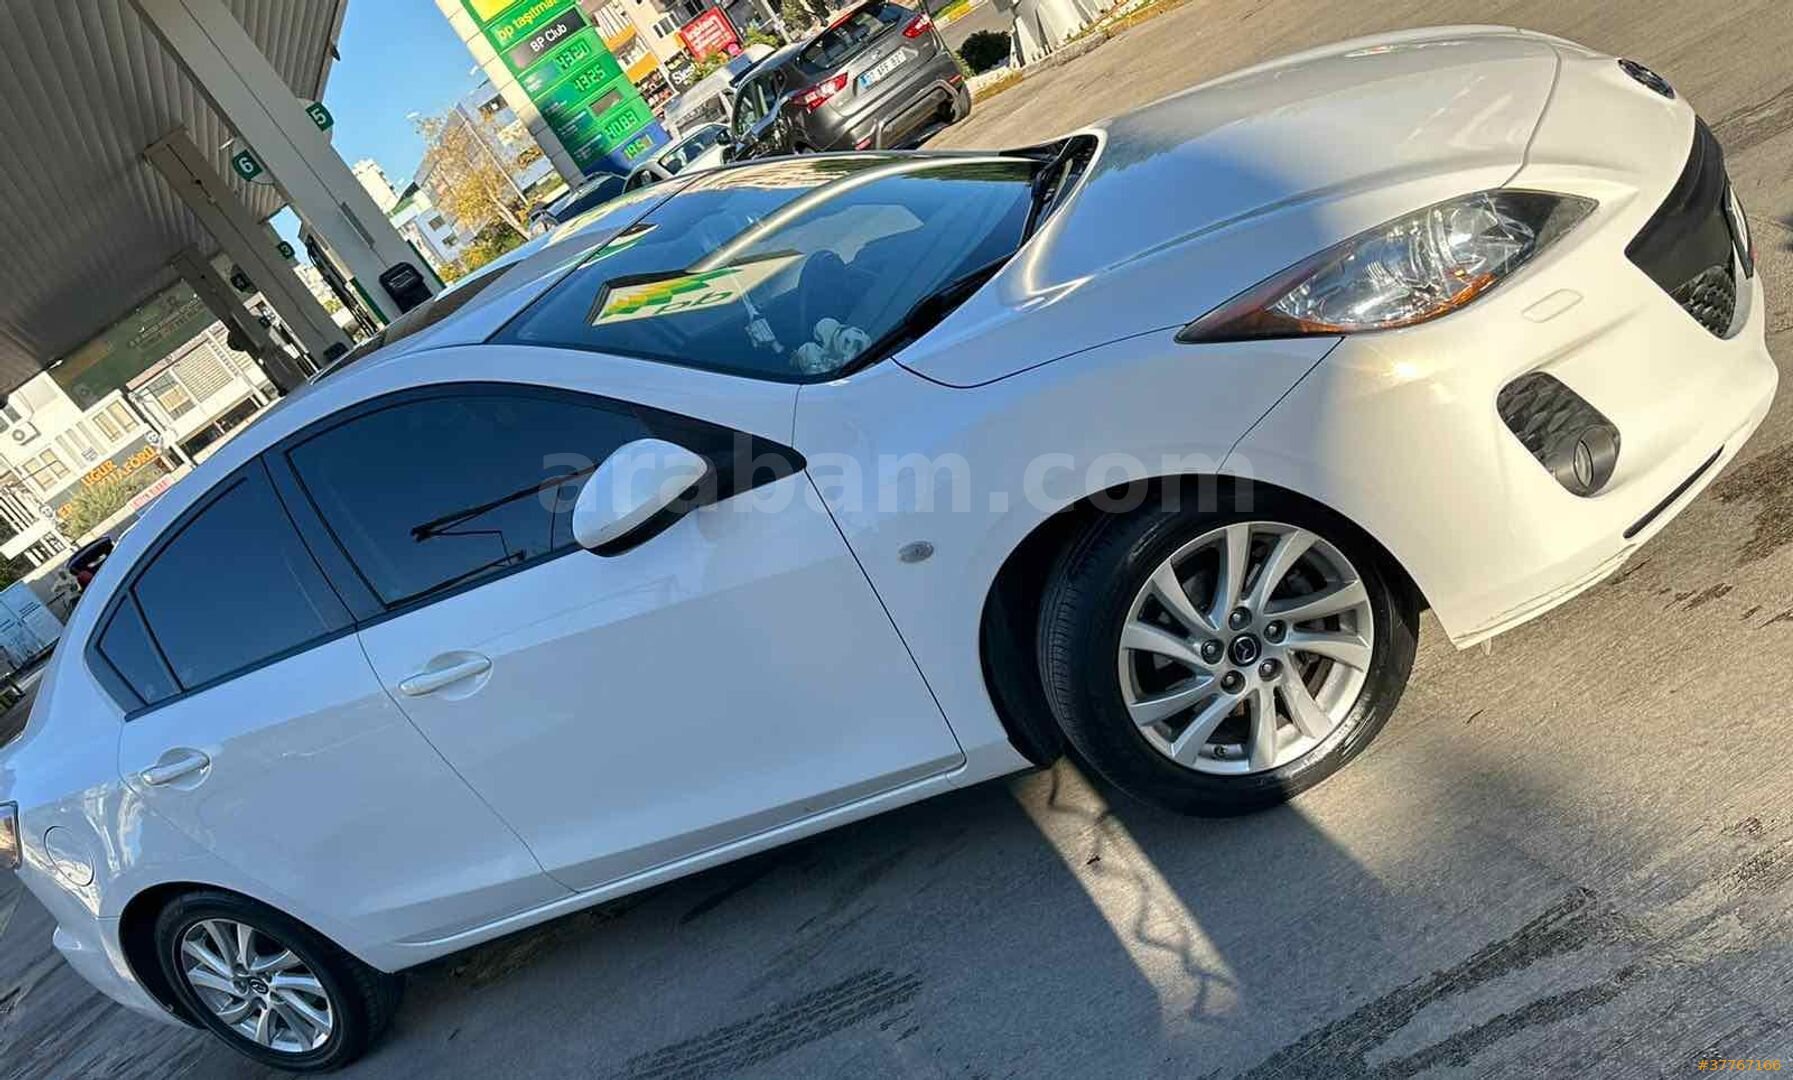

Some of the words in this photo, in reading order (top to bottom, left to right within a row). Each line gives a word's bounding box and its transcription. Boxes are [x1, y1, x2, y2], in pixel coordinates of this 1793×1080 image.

[513, 0, 557, 28] taşıtma
[529, 36, 545, 52] BP
[545, 23, 567, 42] Club
[310, 107, 327, 125] 5
[238, 156, 254, 173] 6
